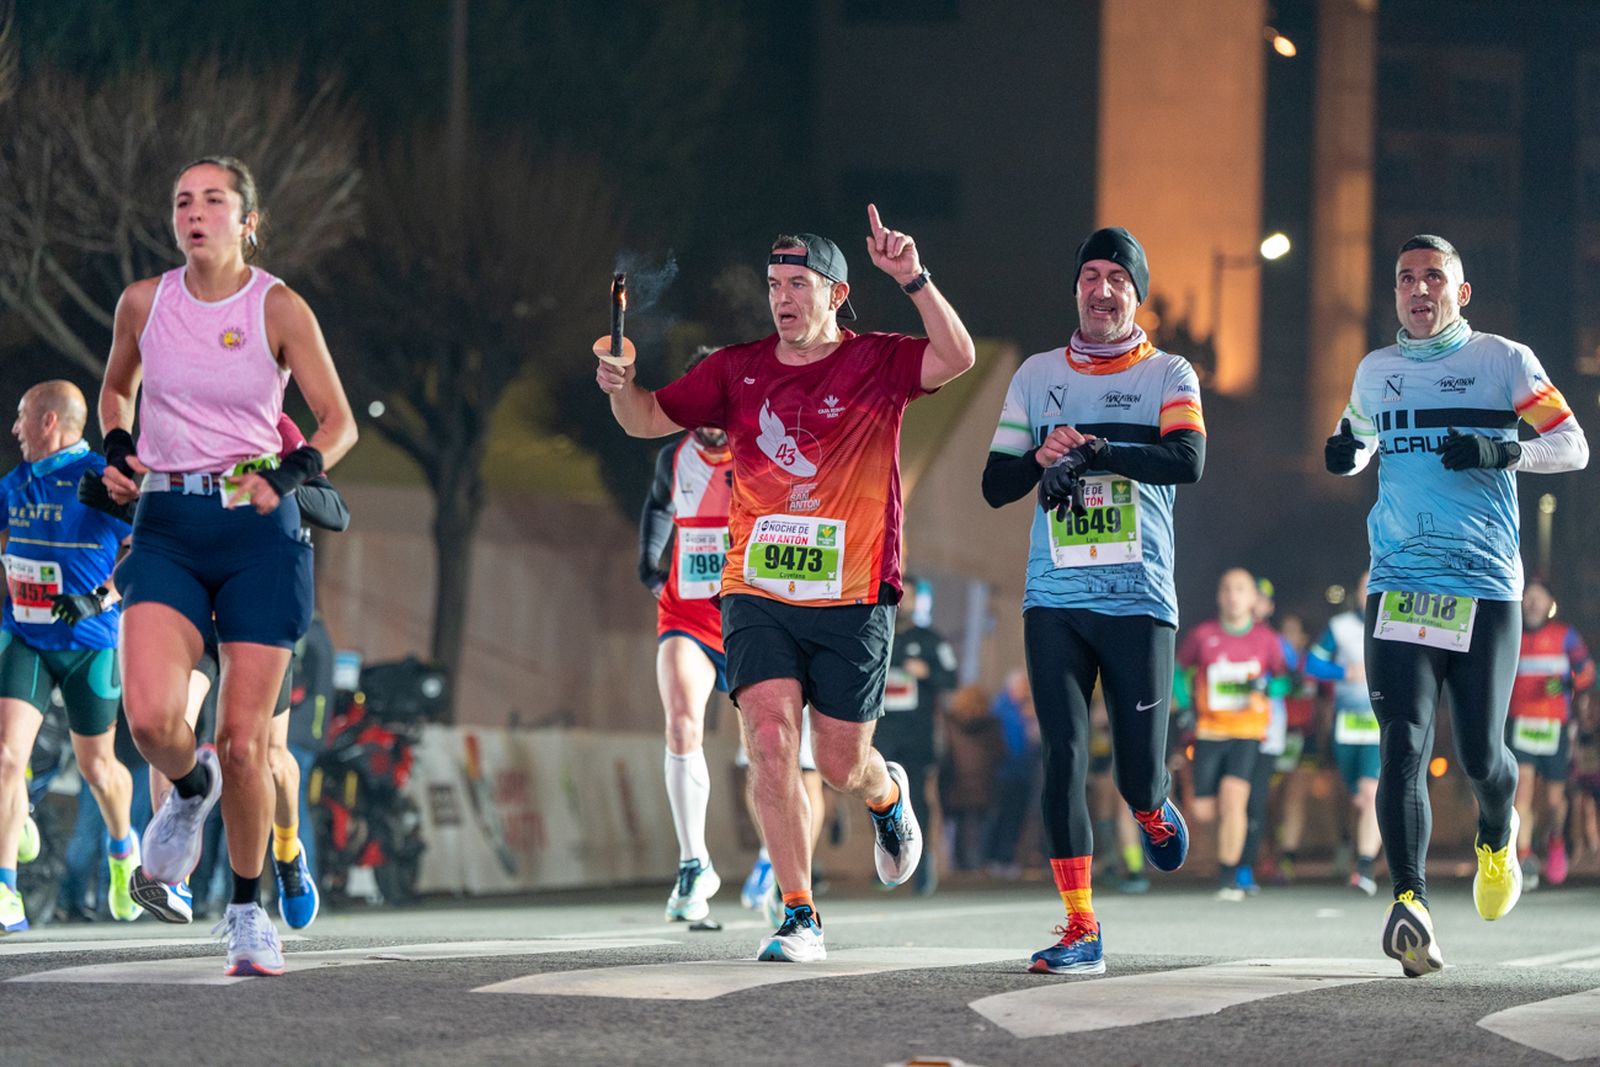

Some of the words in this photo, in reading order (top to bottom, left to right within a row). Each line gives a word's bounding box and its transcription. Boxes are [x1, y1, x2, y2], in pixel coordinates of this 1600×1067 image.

[775, 443, 796, 466] 43
[1091, 485, 1104, 495] DE
[1085, 496, 1104, 507] TÓN
[768, 522, 797, 534] NOCHE
[798, 525, 810, 535] DE
[1065, 507, 1121, 536] 1649
[758, 533, 776, 543] SAN
[764, 544, 823, 573] 9473
[1398, 591, 1458, 621] 3018
